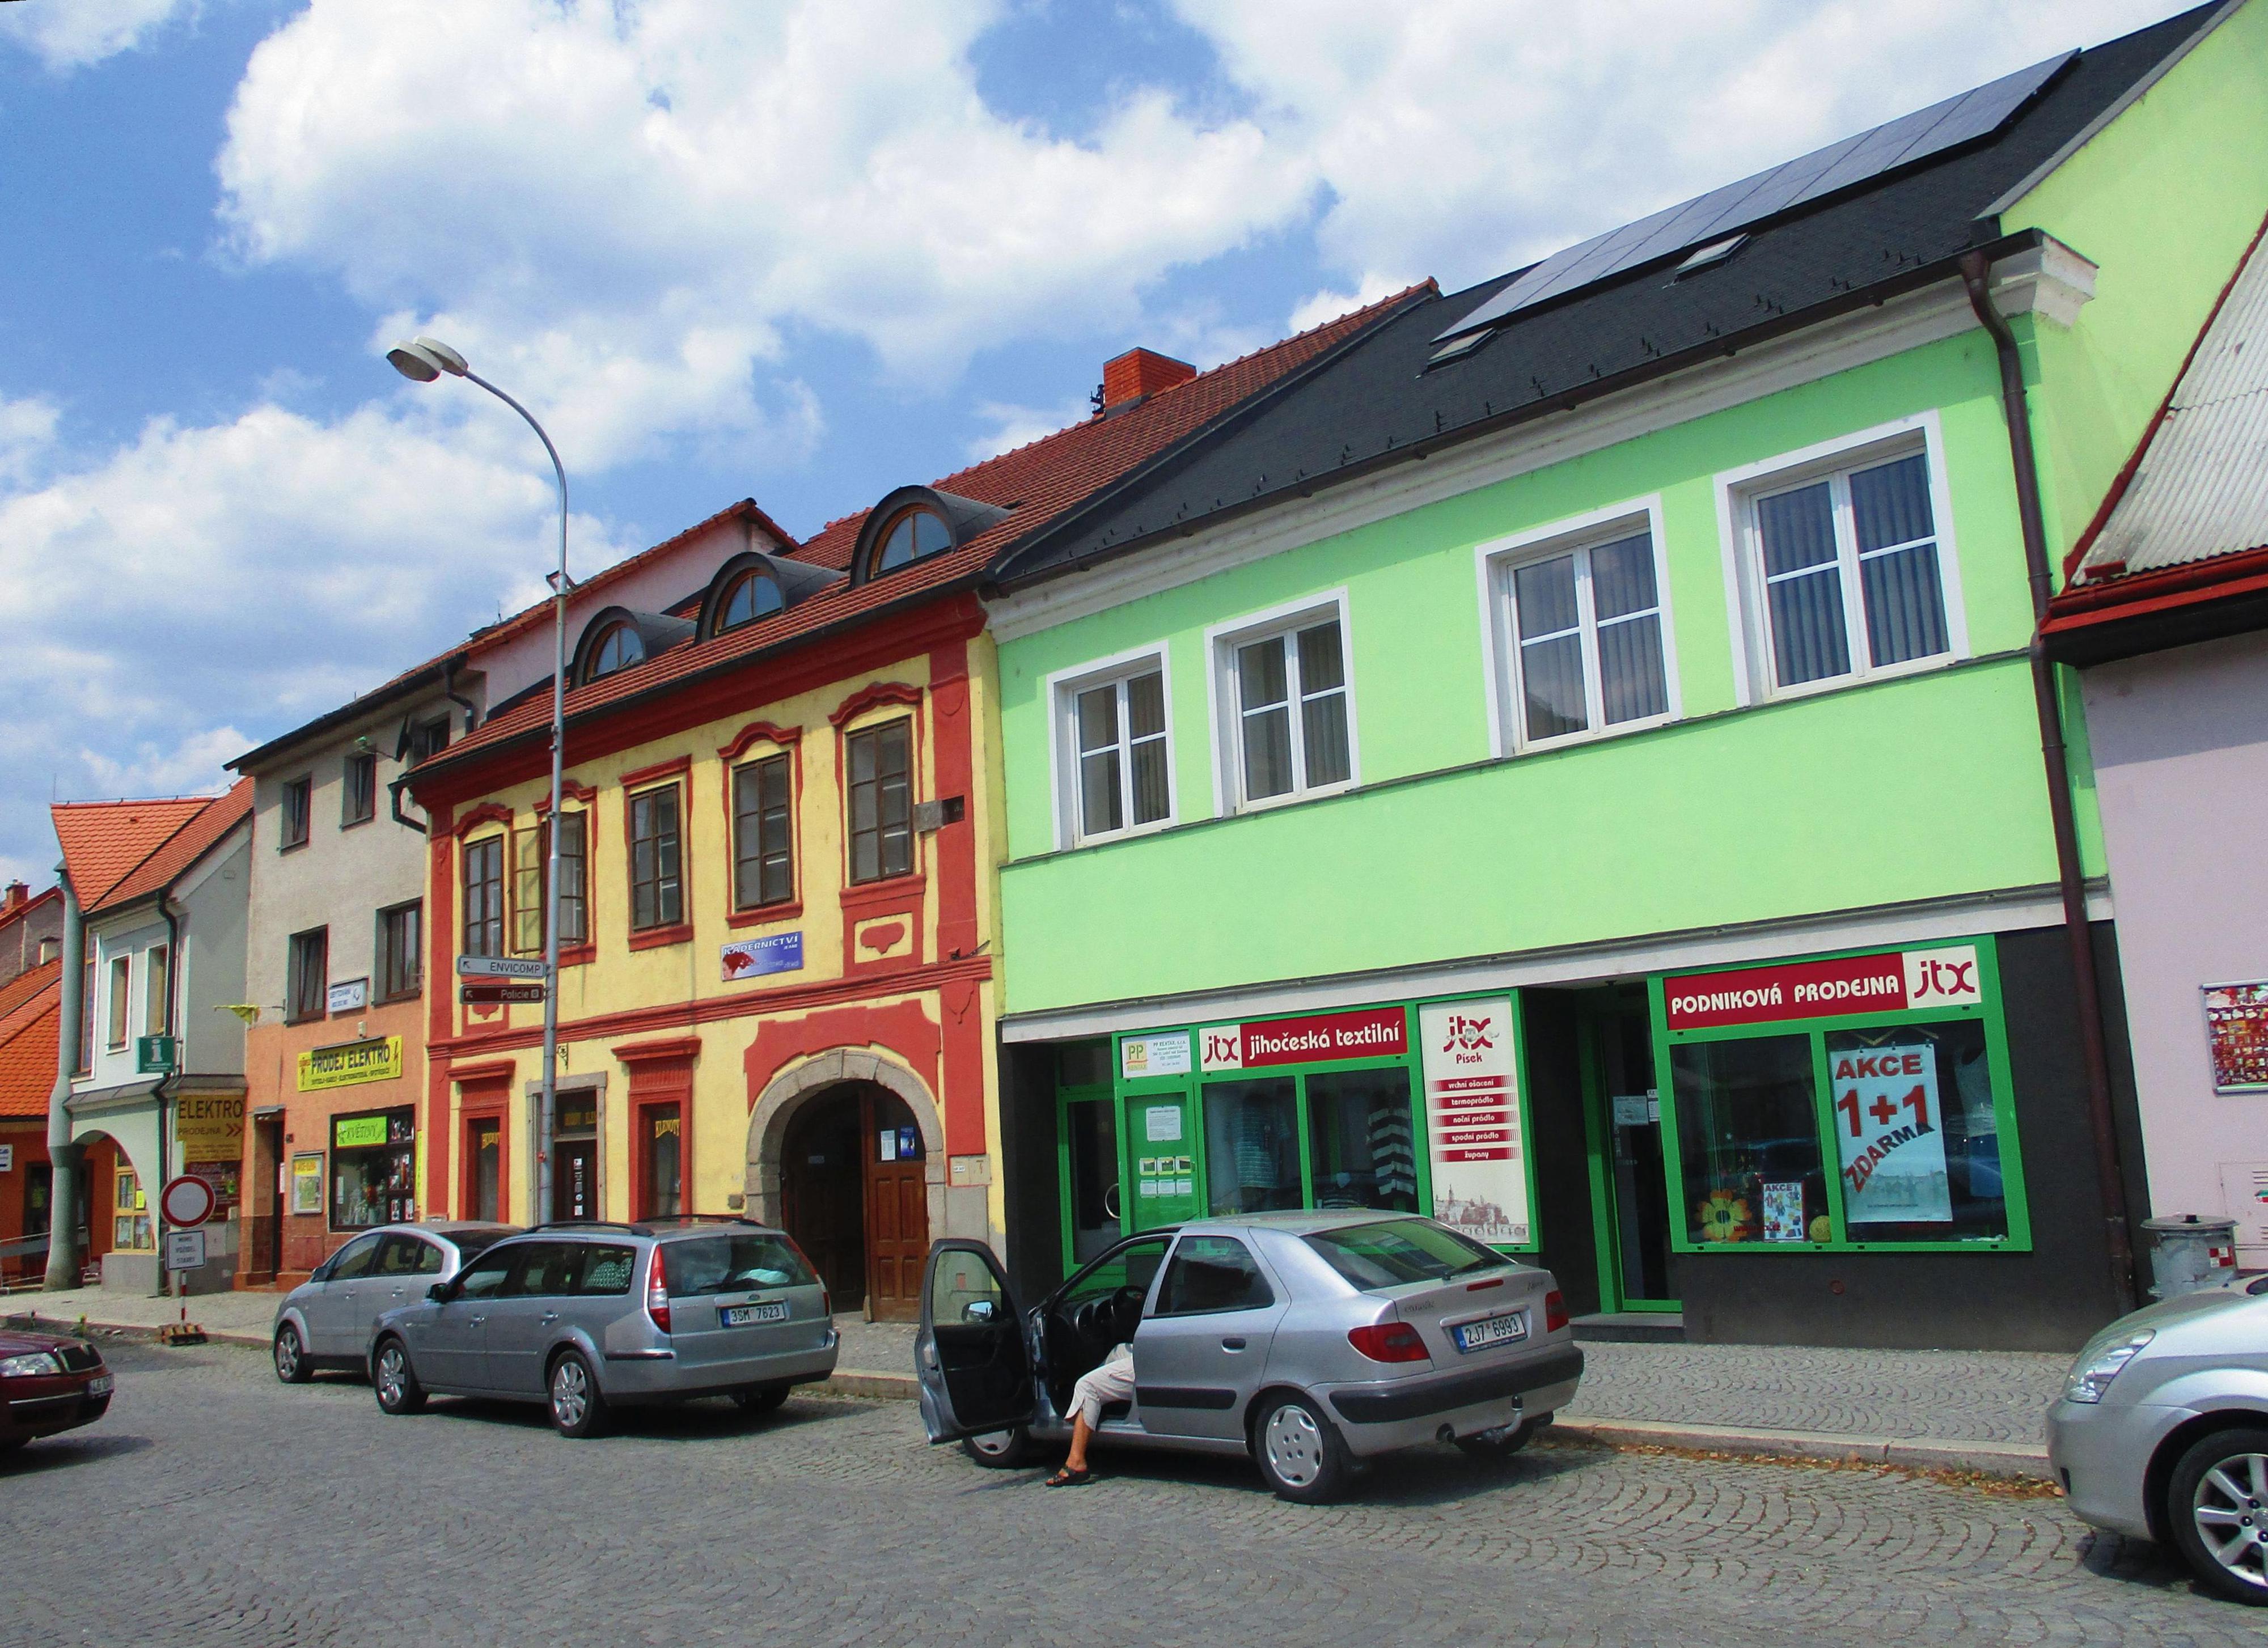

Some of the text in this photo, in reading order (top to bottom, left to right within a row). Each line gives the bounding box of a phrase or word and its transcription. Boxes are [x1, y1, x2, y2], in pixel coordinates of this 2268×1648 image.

[490, 962, 540, 973] ENVICOMP
[1914, 959, 1975, 998] jtx
[501, 989, 529, 999] Policie
[1672, 975, 1899, 1015] PODNIKOVÁ PRODEJNA
[1249, 1020, 1400, 1060] jihočeská textilní
[1128, 1044, 1144, 1060] PP
[1204, 1035, 1238, 1064] jtx
[1456, 1052, 1482, 1064] Písek
[312, 1044, 391, 1075] PRODEJ ELEKTRO
[1835, 1054, 1923, 1080] AKCE
[1448, 1078, 1494, 1089] vrchní ošacení
[1452, 1096, 1494, 1105] termoprádlo
[179, 1100, 243, 1119] ELEKTRO
[1838, 1085, 1928, 1137] 1+1
[1453, 1114, 1495, 1124] noční prádlo
[1452, 1131, 1499, 1142] spodní prádlo
[1465, 1151, 1489, 1159] župany
[1844, 1122, 1935, 1193] ZDARMA
[731, 1306, 780, 1322] 3SM 7623
[1465, 1317, 1519, 1344] 2J7 6993
